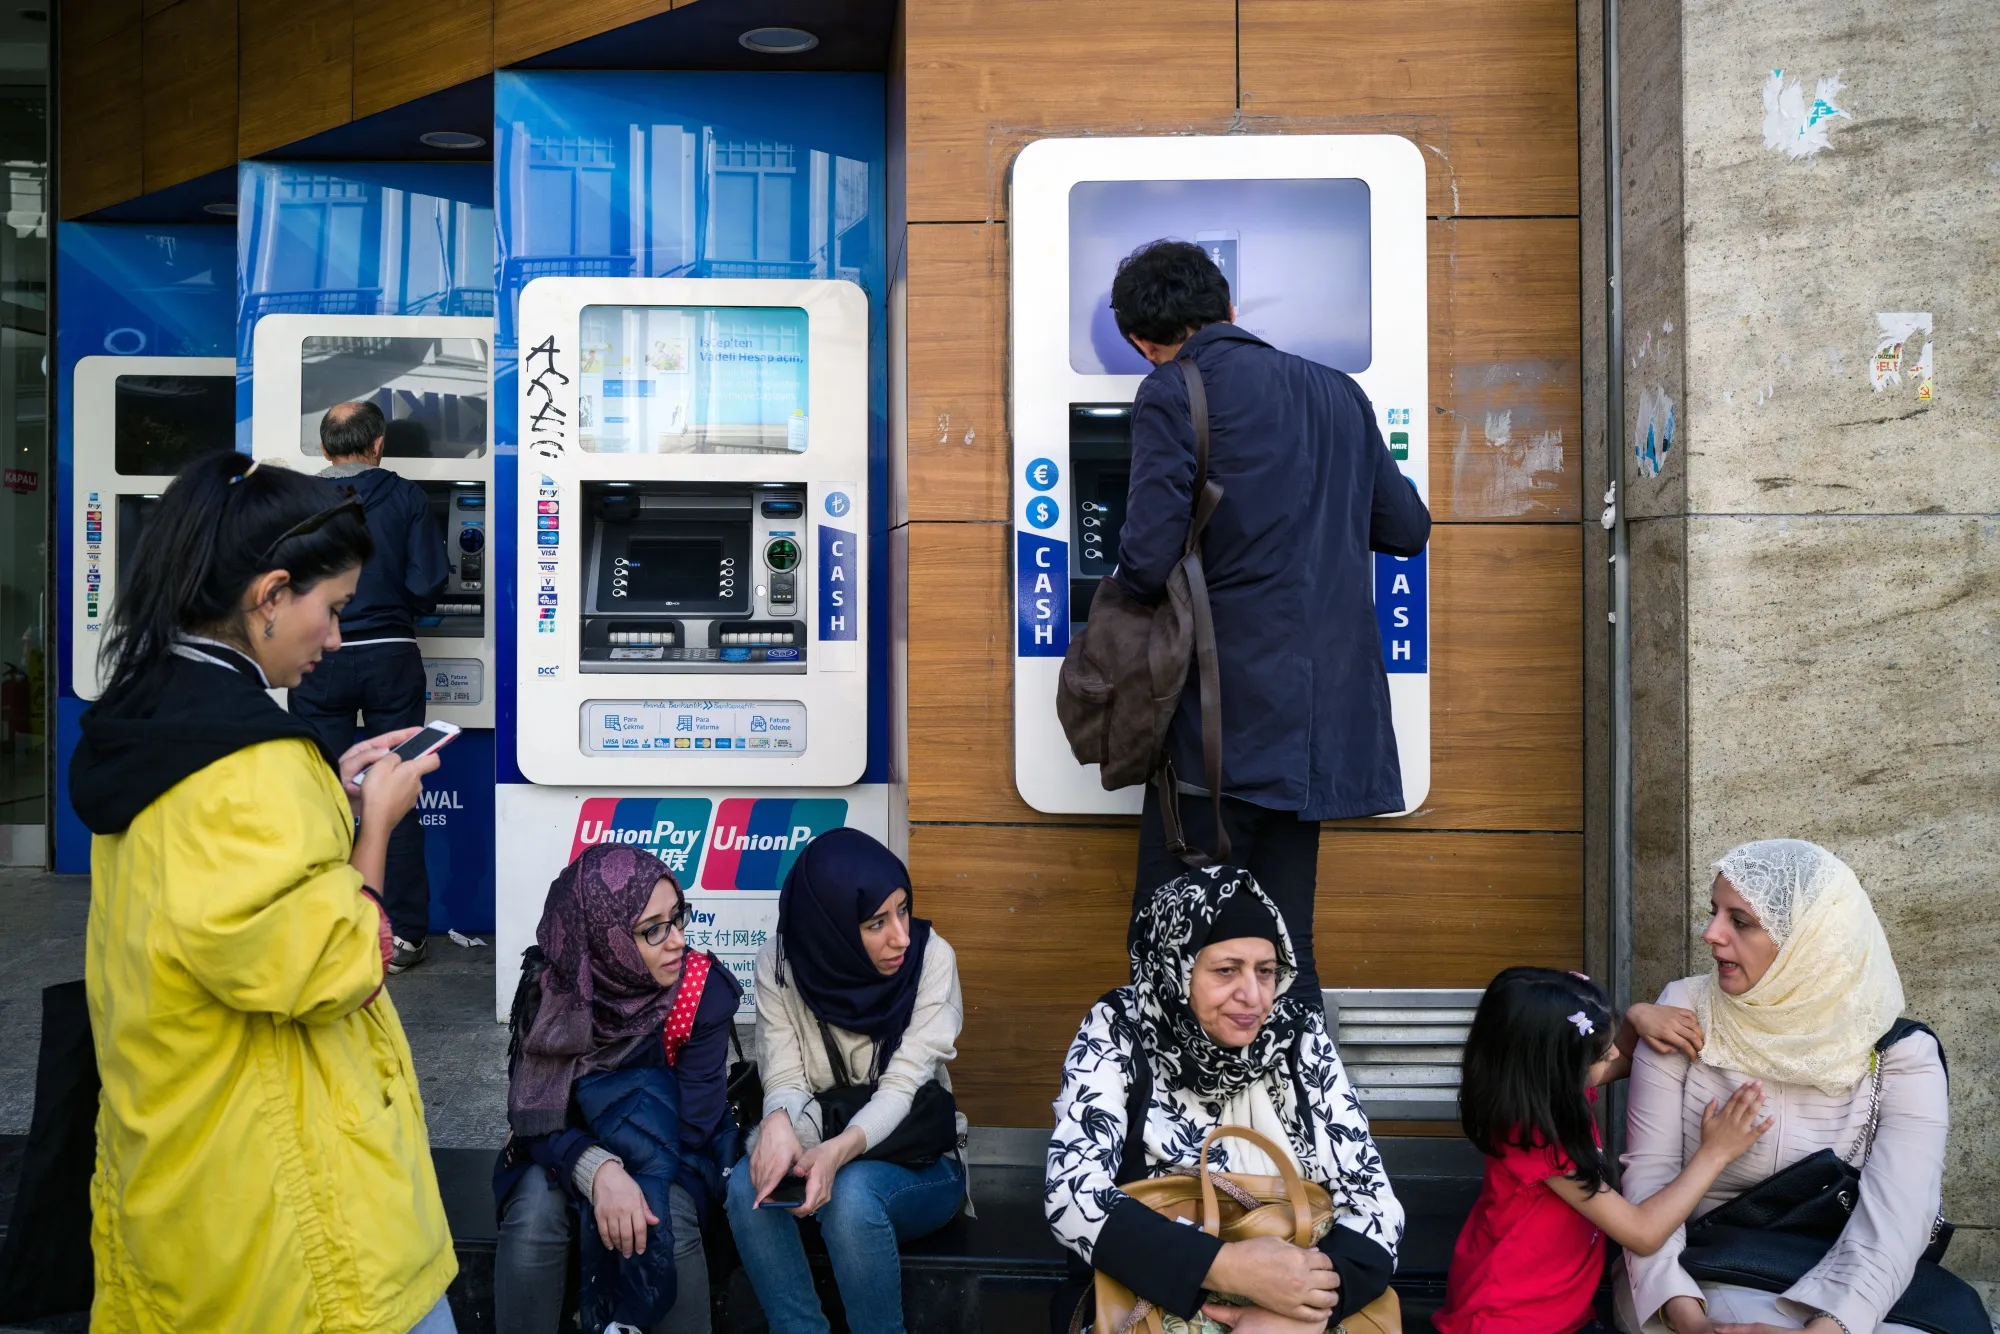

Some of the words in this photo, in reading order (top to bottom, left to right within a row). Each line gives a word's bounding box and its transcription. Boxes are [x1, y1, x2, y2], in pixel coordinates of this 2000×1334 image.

[700, 351, 736, 362] Vadeli
[738, 352, 774, 363] Hesap
[5, 471, 37, 486] KAPALI
[539, 488, 558, 498] troy
[831, 541, 845, 631] CASH
[1034, 547, 1053, 645] CASH
[1391, 555, 1411, 660] ASH
[538, 667, 556, 675] DCC
[580, 820, 702, 853] UnionPay
[713, 826, 817, 851] UnionP
